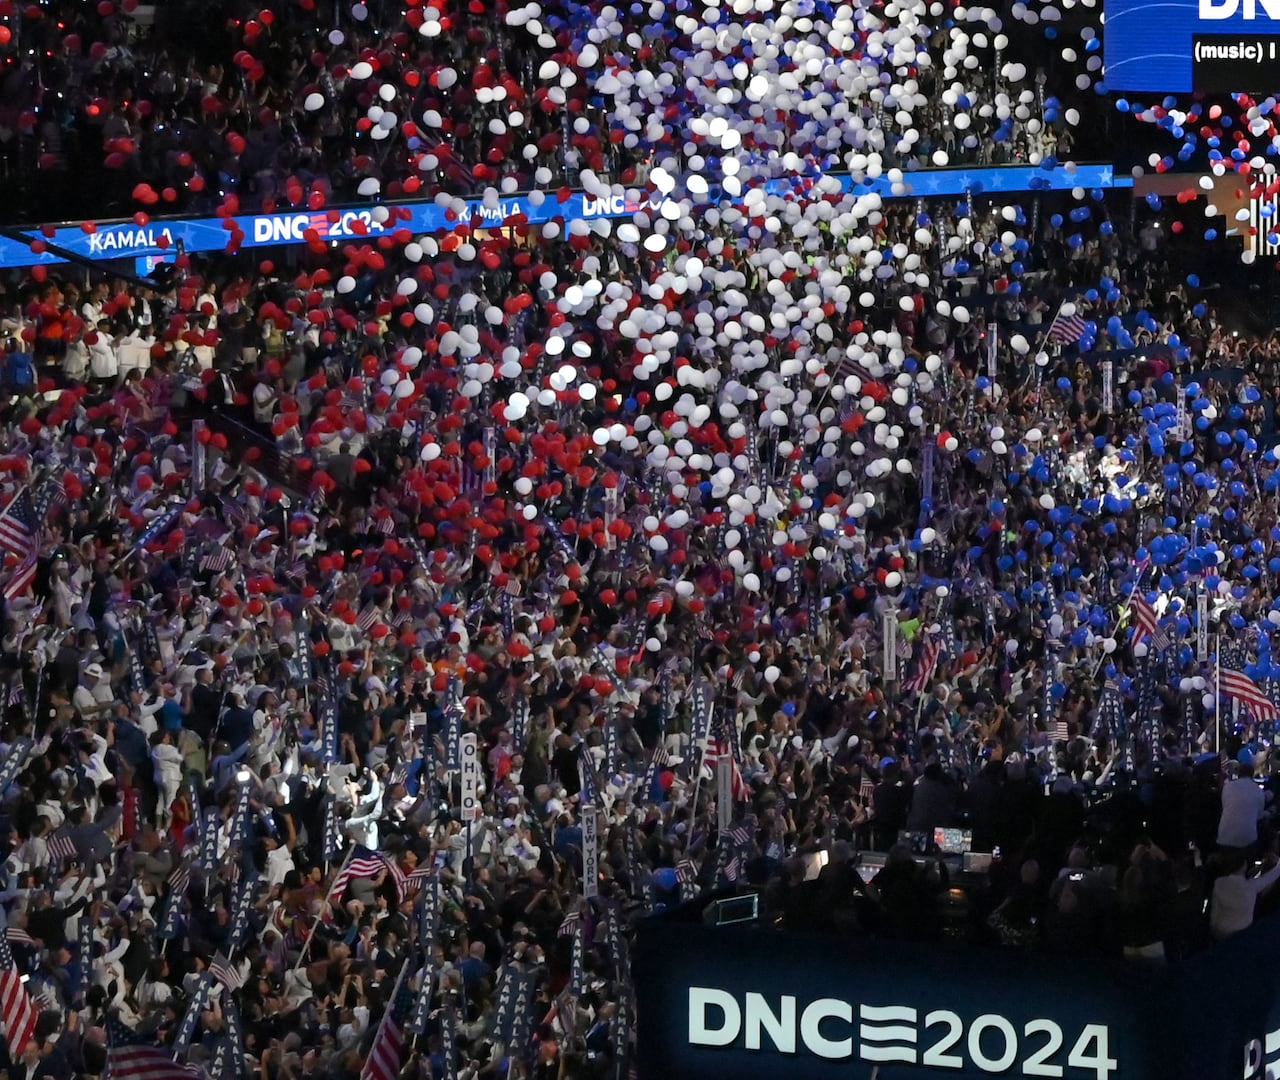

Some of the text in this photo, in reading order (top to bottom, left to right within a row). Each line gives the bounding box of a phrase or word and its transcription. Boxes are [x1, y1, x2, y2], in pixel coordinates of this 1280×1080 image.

[1194, 40, 1264, 64] (music)
[1270, 42, 1275, 60] I
[254, 214, 307, 243] DNC
[1046, 670, 1054, 711] KAMALA
[325, 708, 334, 762] KAMALA
[447, 716, 457, 766] KAMALA
[607, 725, 616, 775] KAMALA
[464, 744, 475, 809] OHIO
[204, 813, 217, 871] KAMALA
[231, 785, 250, 843] KAMALA
[585, 816, 596, 885] NEW YORK
[232, 880, 254, 940] KAMALA
[425, 882, 434, 940] KAMALA
[80, 924, 90, 985] KAMALA
[572, 928, 581, 990] KAMALA
[414, 964, 433, 1027] KAMALA
[509, 981, 528, 1048] KAMALA
[618, 995, 628, 1047] KAMALA
[688, 984, 1118, 1080] DNC 2024
